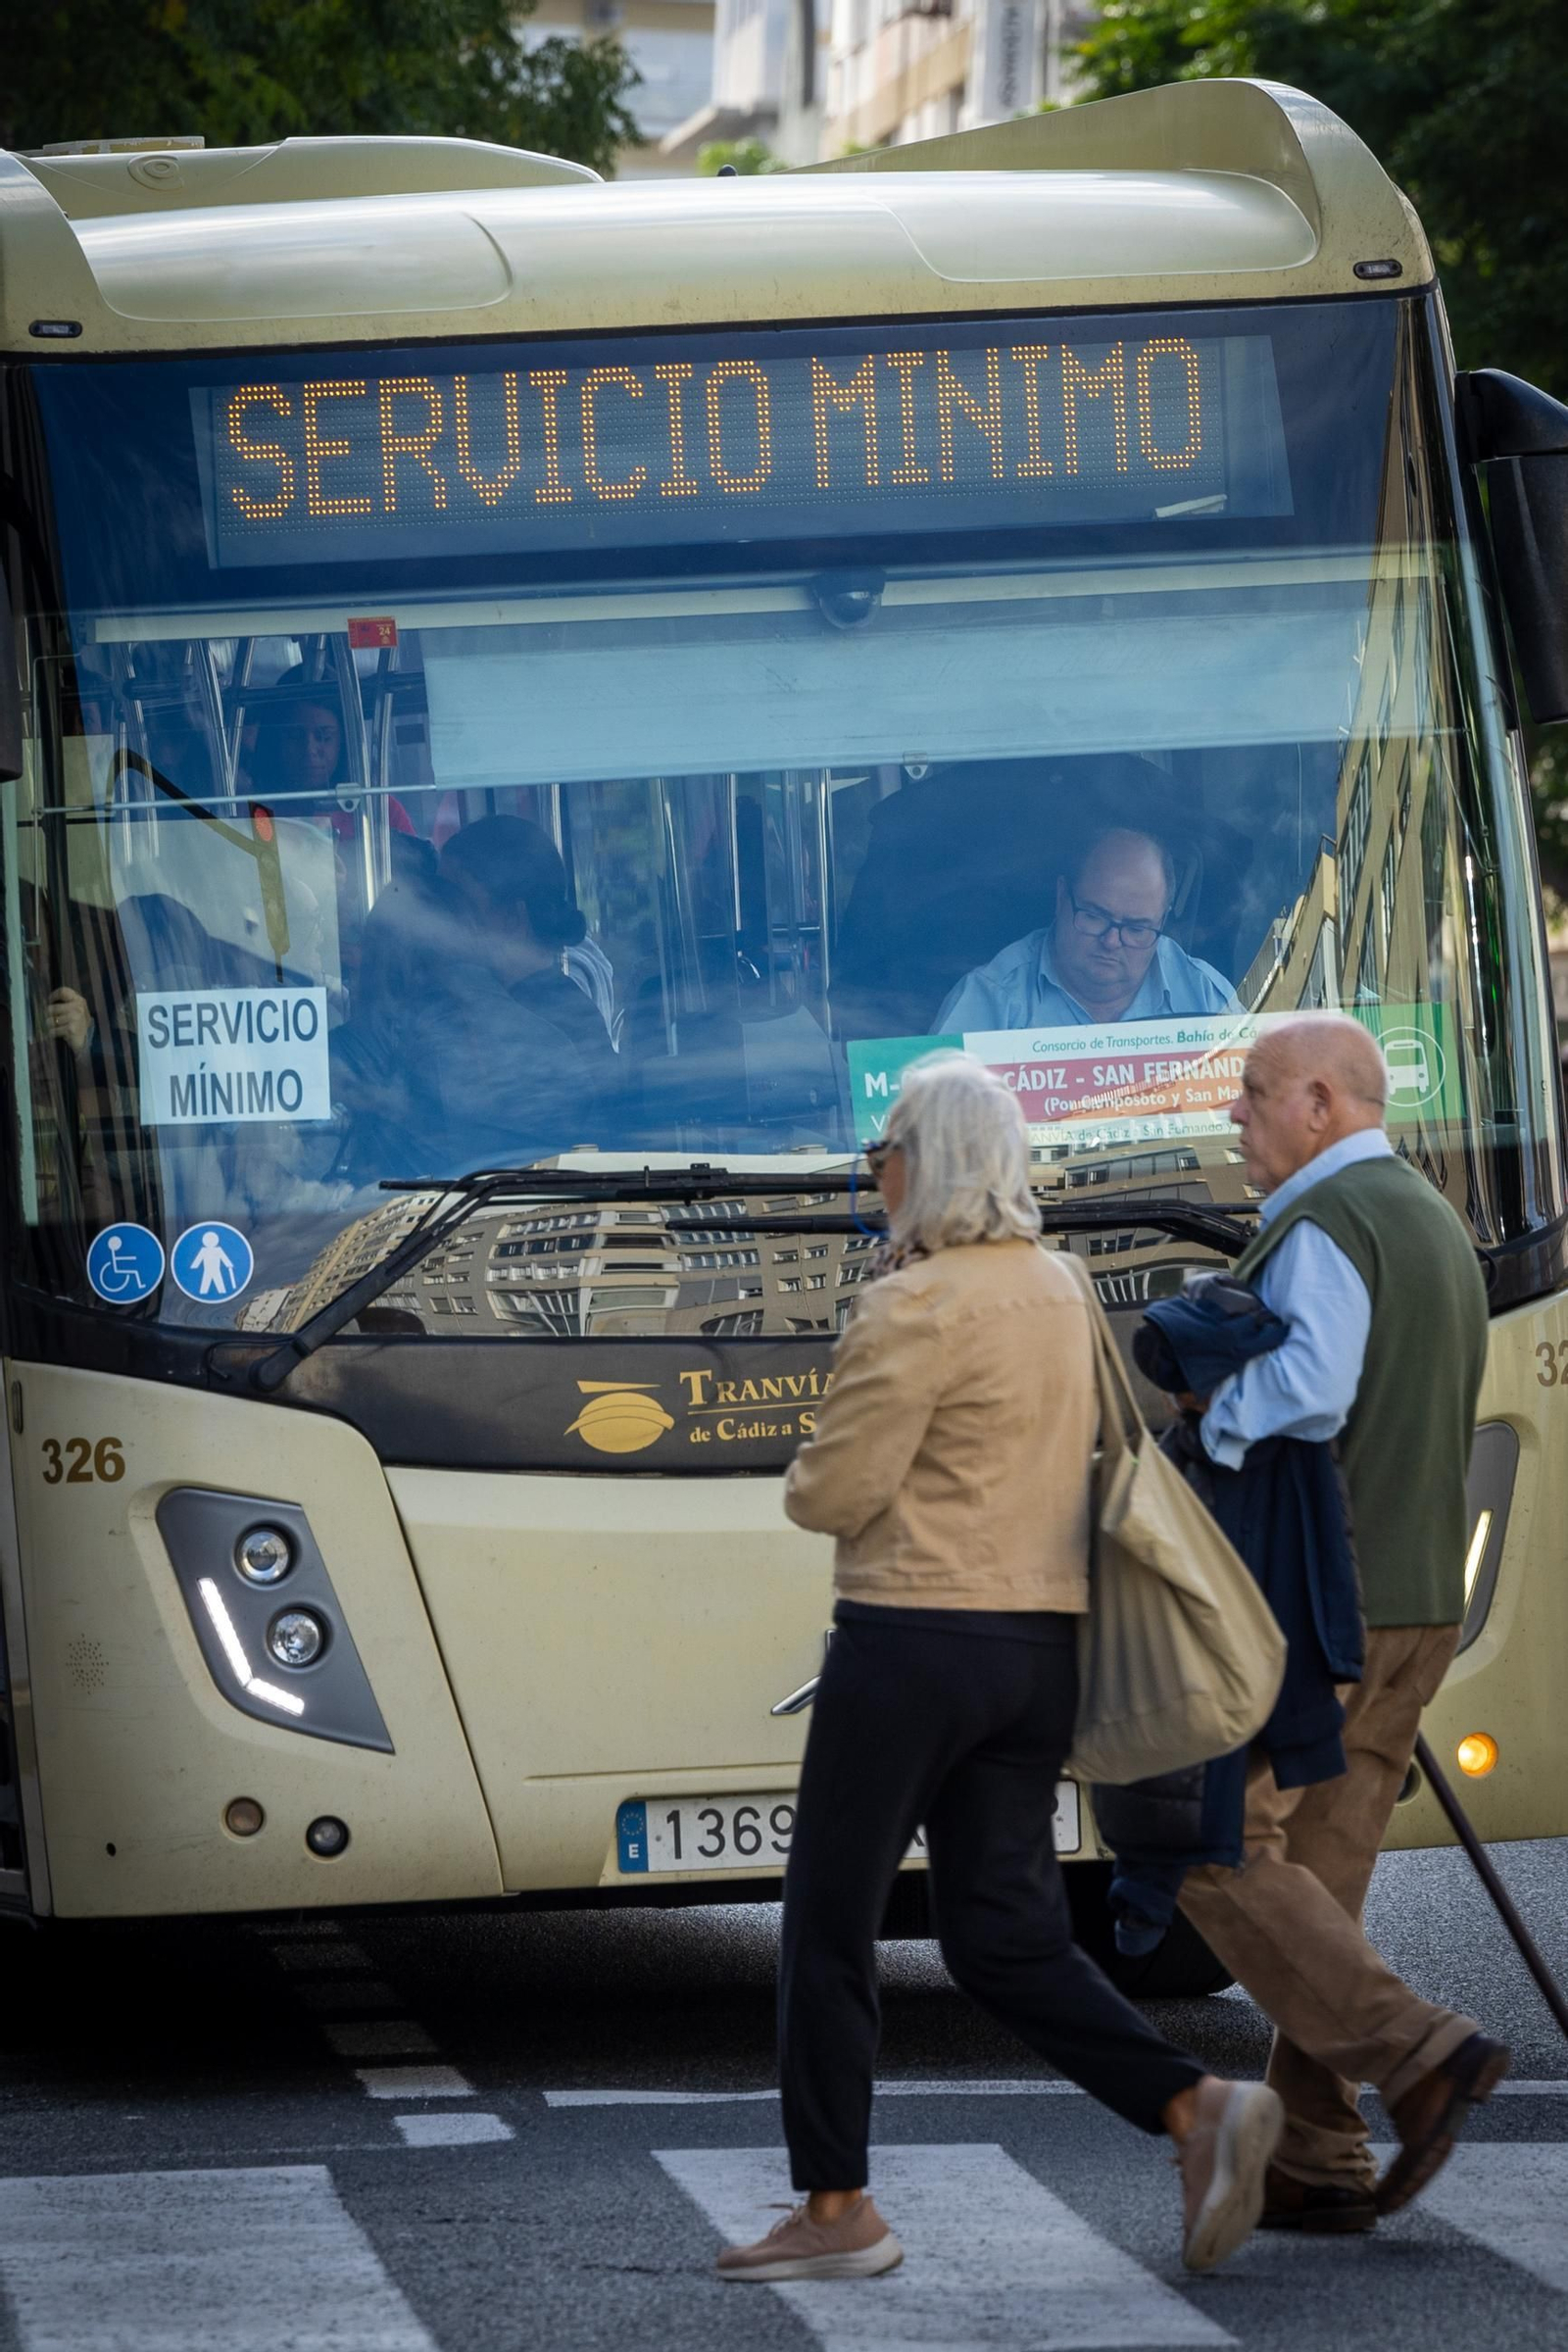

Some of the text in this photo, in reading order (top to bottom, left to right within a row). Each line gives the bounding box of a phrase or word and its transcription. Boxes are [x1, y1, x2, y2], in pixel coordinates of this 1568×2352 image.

[227, 337, 1202, 519] SERVICIO MINIMO
[148, 998, 318, 1050] SERVICIO
[1032, 1040, 1086, 1053] Consorcio
[1090, 1037, 1104, 1050] de
[1177, 1029, 1214, 1044] Bahía
[1239, 1026, 1260, 1039] Cá
[170, 1061, 304, 1117] MÍNIMO
[1003, 1064, 1068, 1092] CÁDIZ
[1093, 1063, 1135, 1087] SAN
[1172, 1093, 1181, 1108] y
[1186, 1088, 1212, 1102] San
[690, 1426, 710, 1443] de
[716, 1418, 777, 1441] Cádiz
[781, 1423, 792, 1436] a
[41, 1437, 125, 1485] 326
[628, 1804, 798, 1860] E 1369
